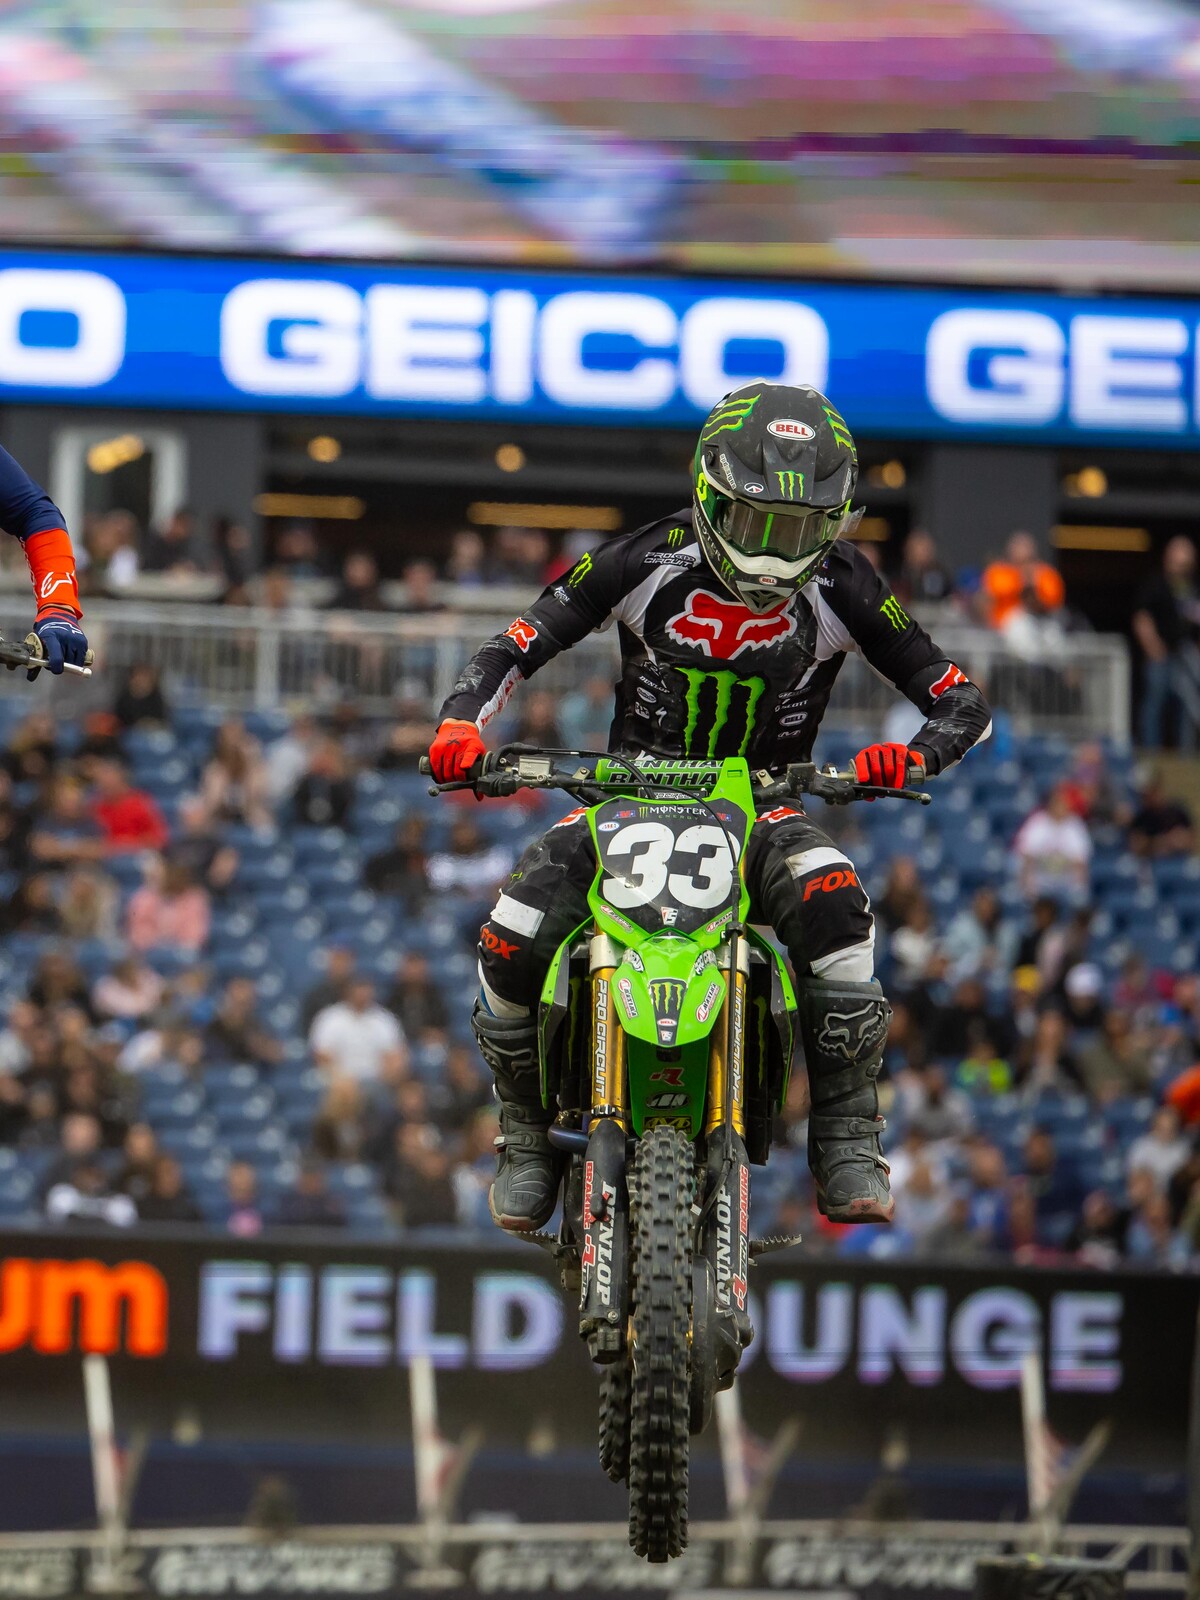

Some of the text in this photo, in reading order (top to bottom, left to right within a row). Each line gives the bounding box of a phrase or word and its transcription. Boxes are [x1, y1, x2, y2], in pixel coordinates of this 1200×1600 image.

[220, 278, 828, 415] GEICO
[925, 308, 1200, 434] GE
[775, 424, 809, 437] BELL
[643, 557, 695, 568] CIRCUIT
[645, 551, 675, 560] PRO
[639, 675, 671, 694] DUNLOP
[649, 805, 708, 817] MONSTER
[603, 822, 741, 909] 33
[803, 870, 858, 902] FOX
[595, 978, 608, 1099] PRO CIRCUIT
[739, 1164, 749, 1237] BRAKING
[199, 1262, 564, 1370] FIELD
[595, 1280, 1125, 1392] UNGE
